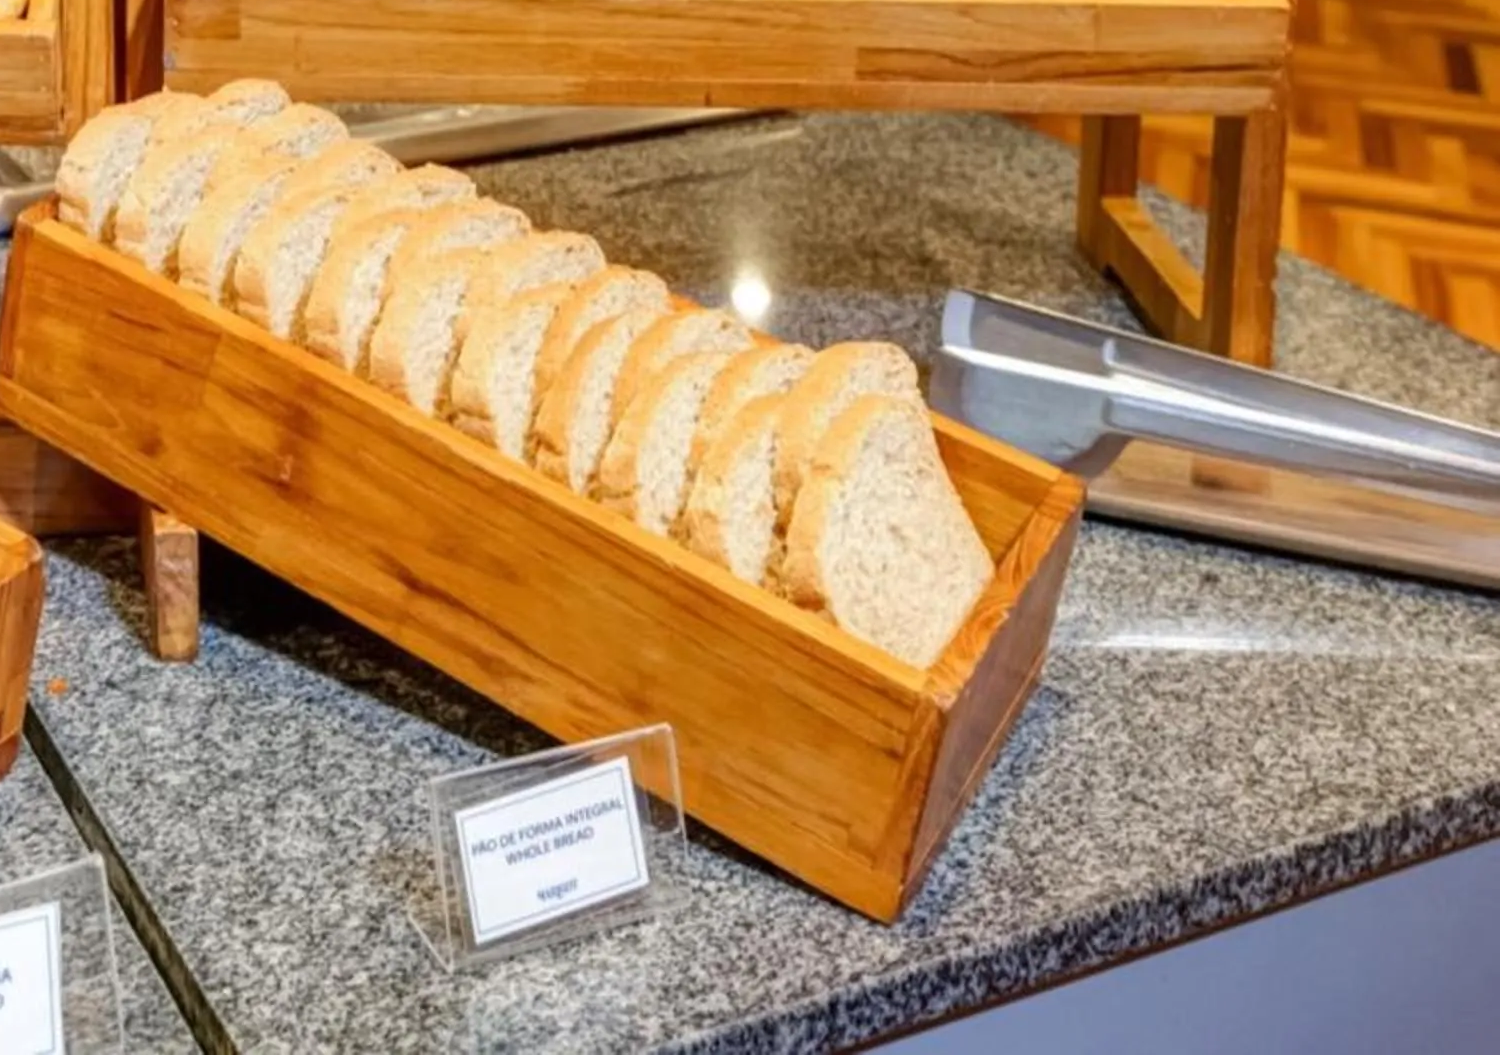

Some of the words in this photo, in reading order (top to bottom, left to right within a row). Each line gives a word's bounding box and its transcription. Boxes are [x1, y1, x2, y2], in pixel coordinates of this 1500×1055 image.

[499, 832, 517, 849] DE
[519, 816, 563, 840] FORMA
[565, 797, 624, 824] INTEGRAL
[505, 841, 551, 866] WHOLE
[554, 826, 595, 849] BREAD
